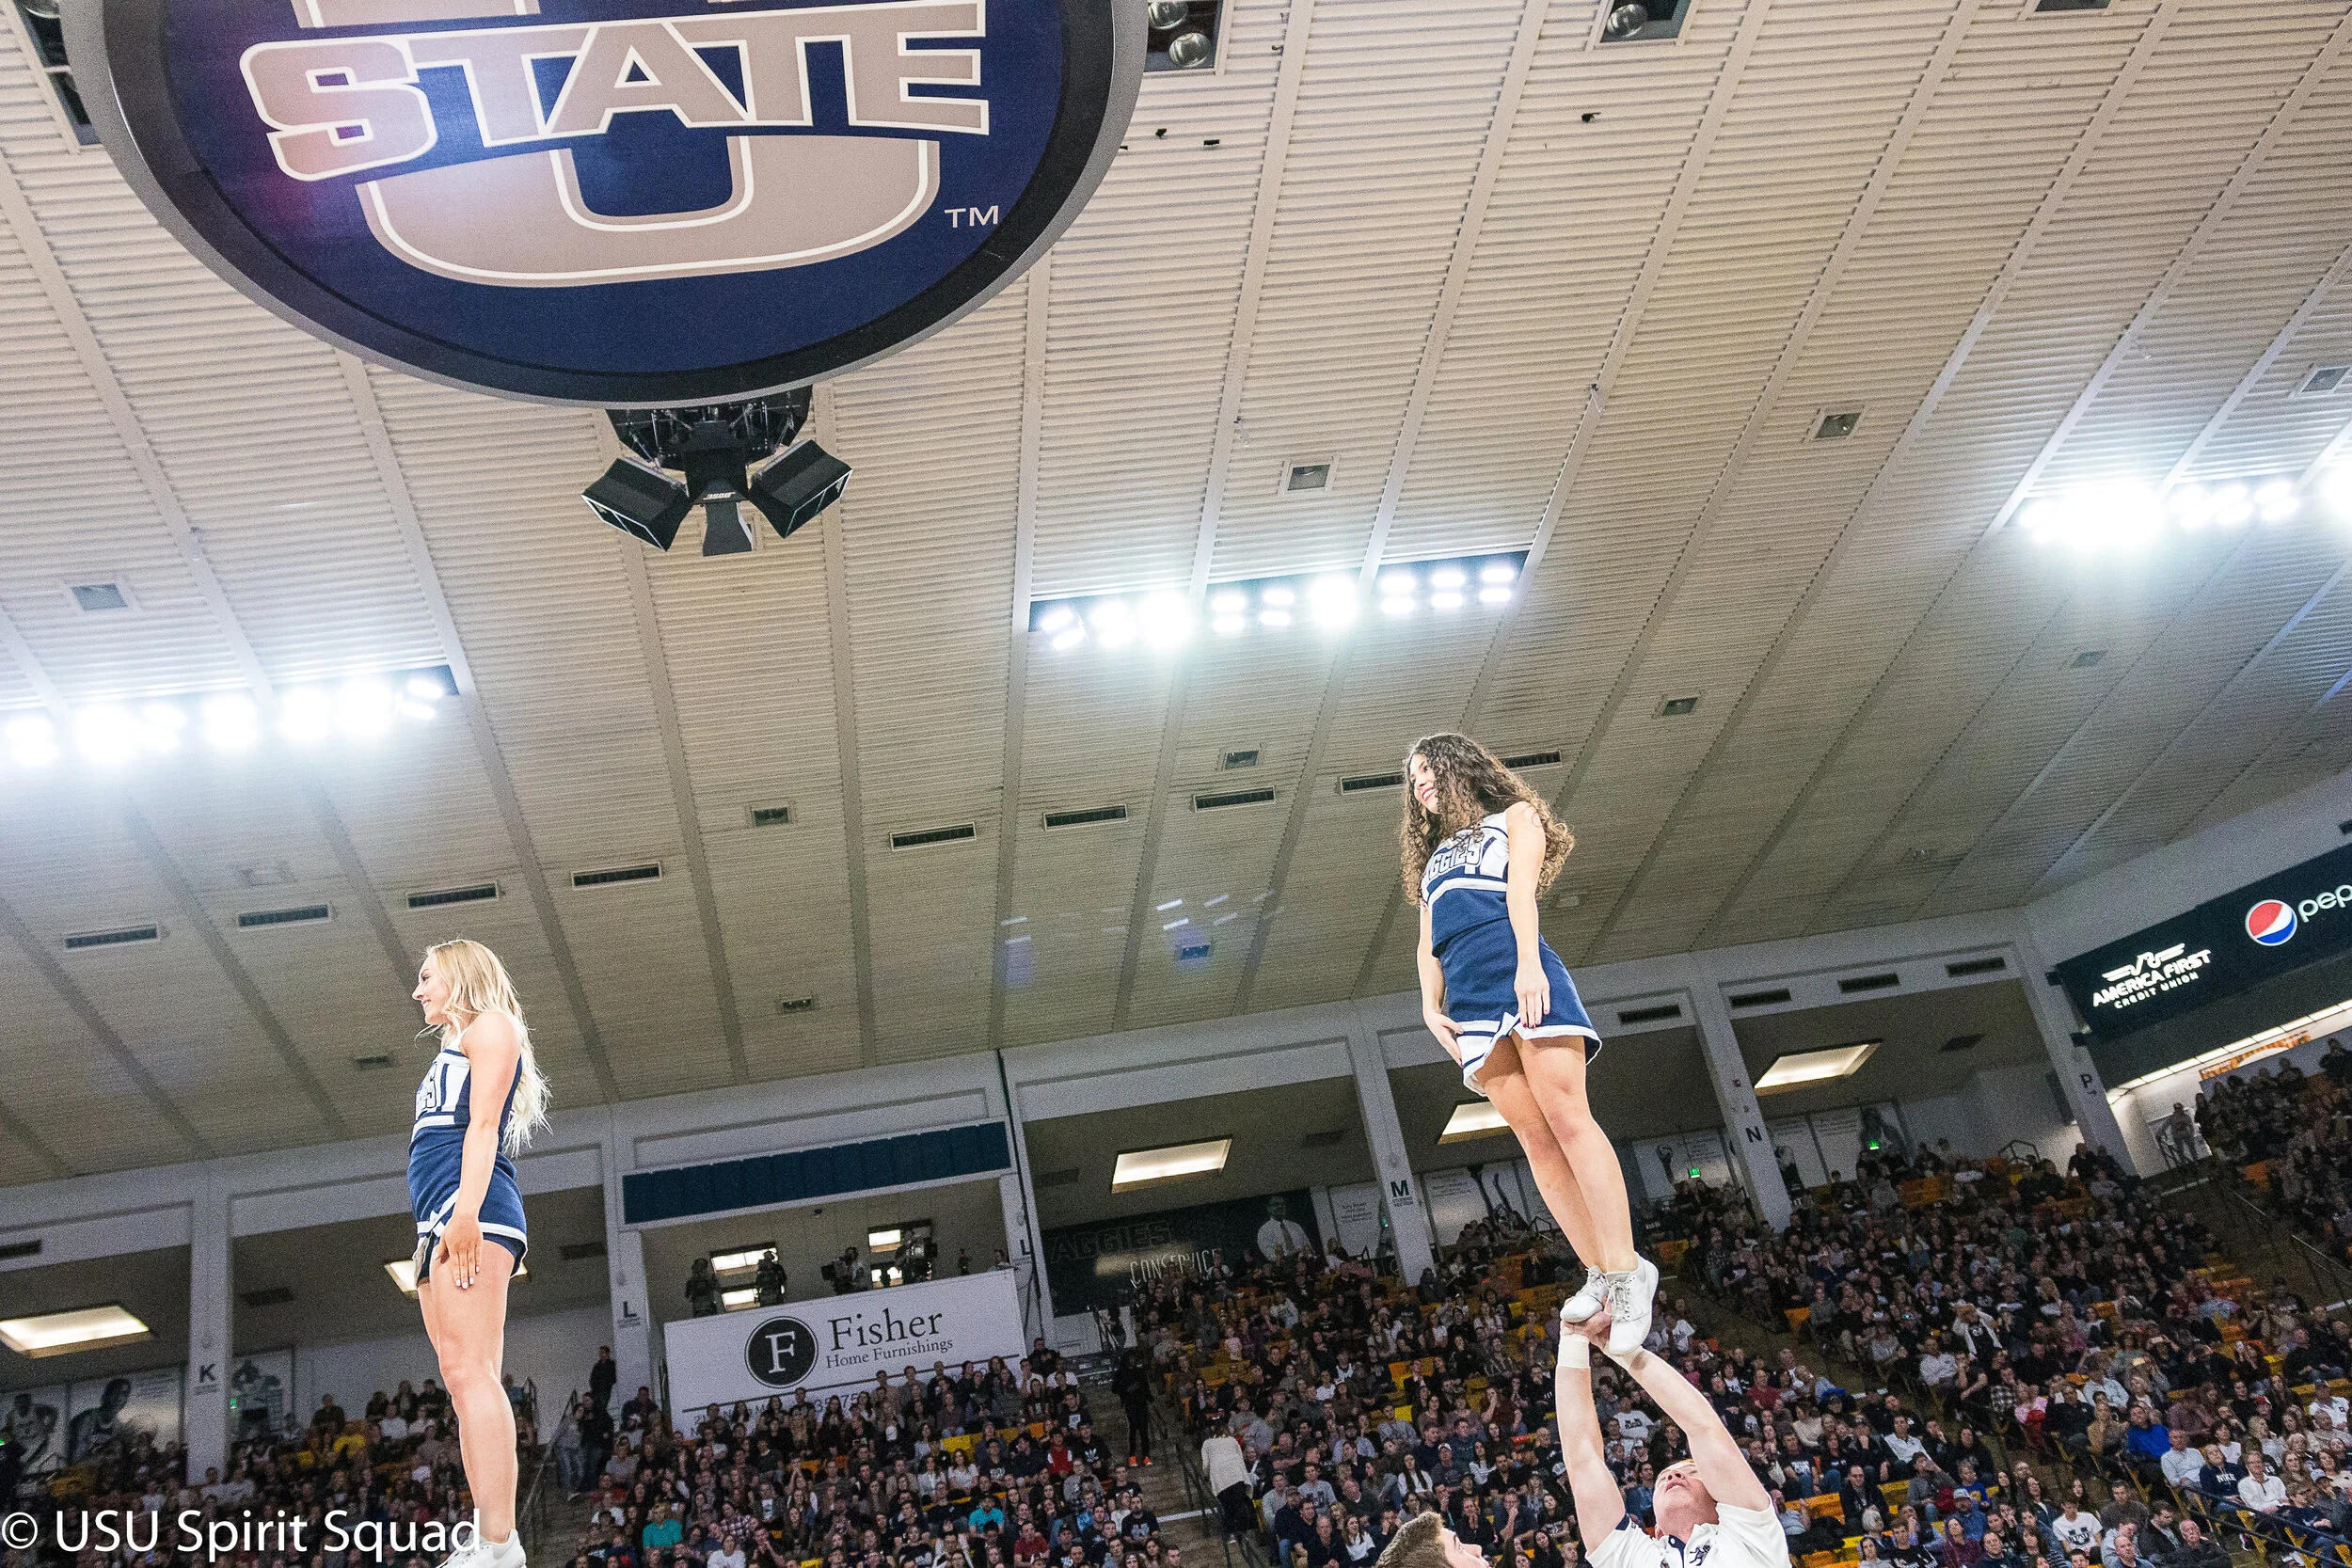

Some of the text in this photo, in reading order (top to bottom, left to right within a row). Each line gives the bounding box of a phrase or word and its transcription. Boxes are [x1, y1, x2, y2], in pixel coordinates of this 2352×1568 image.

[238, 0, 991, 182] STATE
[944, 204, 999, 229] TM
[1428, 835, 1483, 881] GGIES
[2297, 884, 2352, 923] pep
[2093, 949, 2212, 1007] AMERICA FIRST
[2114, 972, 2200, 1009] CREDIT UNION
[2080, 1073, 2093, 1089] P
[1745, 1126, 1763, 1143] N
[1391, 1180, 1409, 1197] M
[623, 1301, 637, 1318] L
[827, 1307, 943, 1352] Fisher
[765, 1330, 797, 1375] F
[826, 1339, 954, 1369] Home Furnishings
[199, 1363, 215, 1384] K
[2216, 1471, 2237, 1483] NIKE
